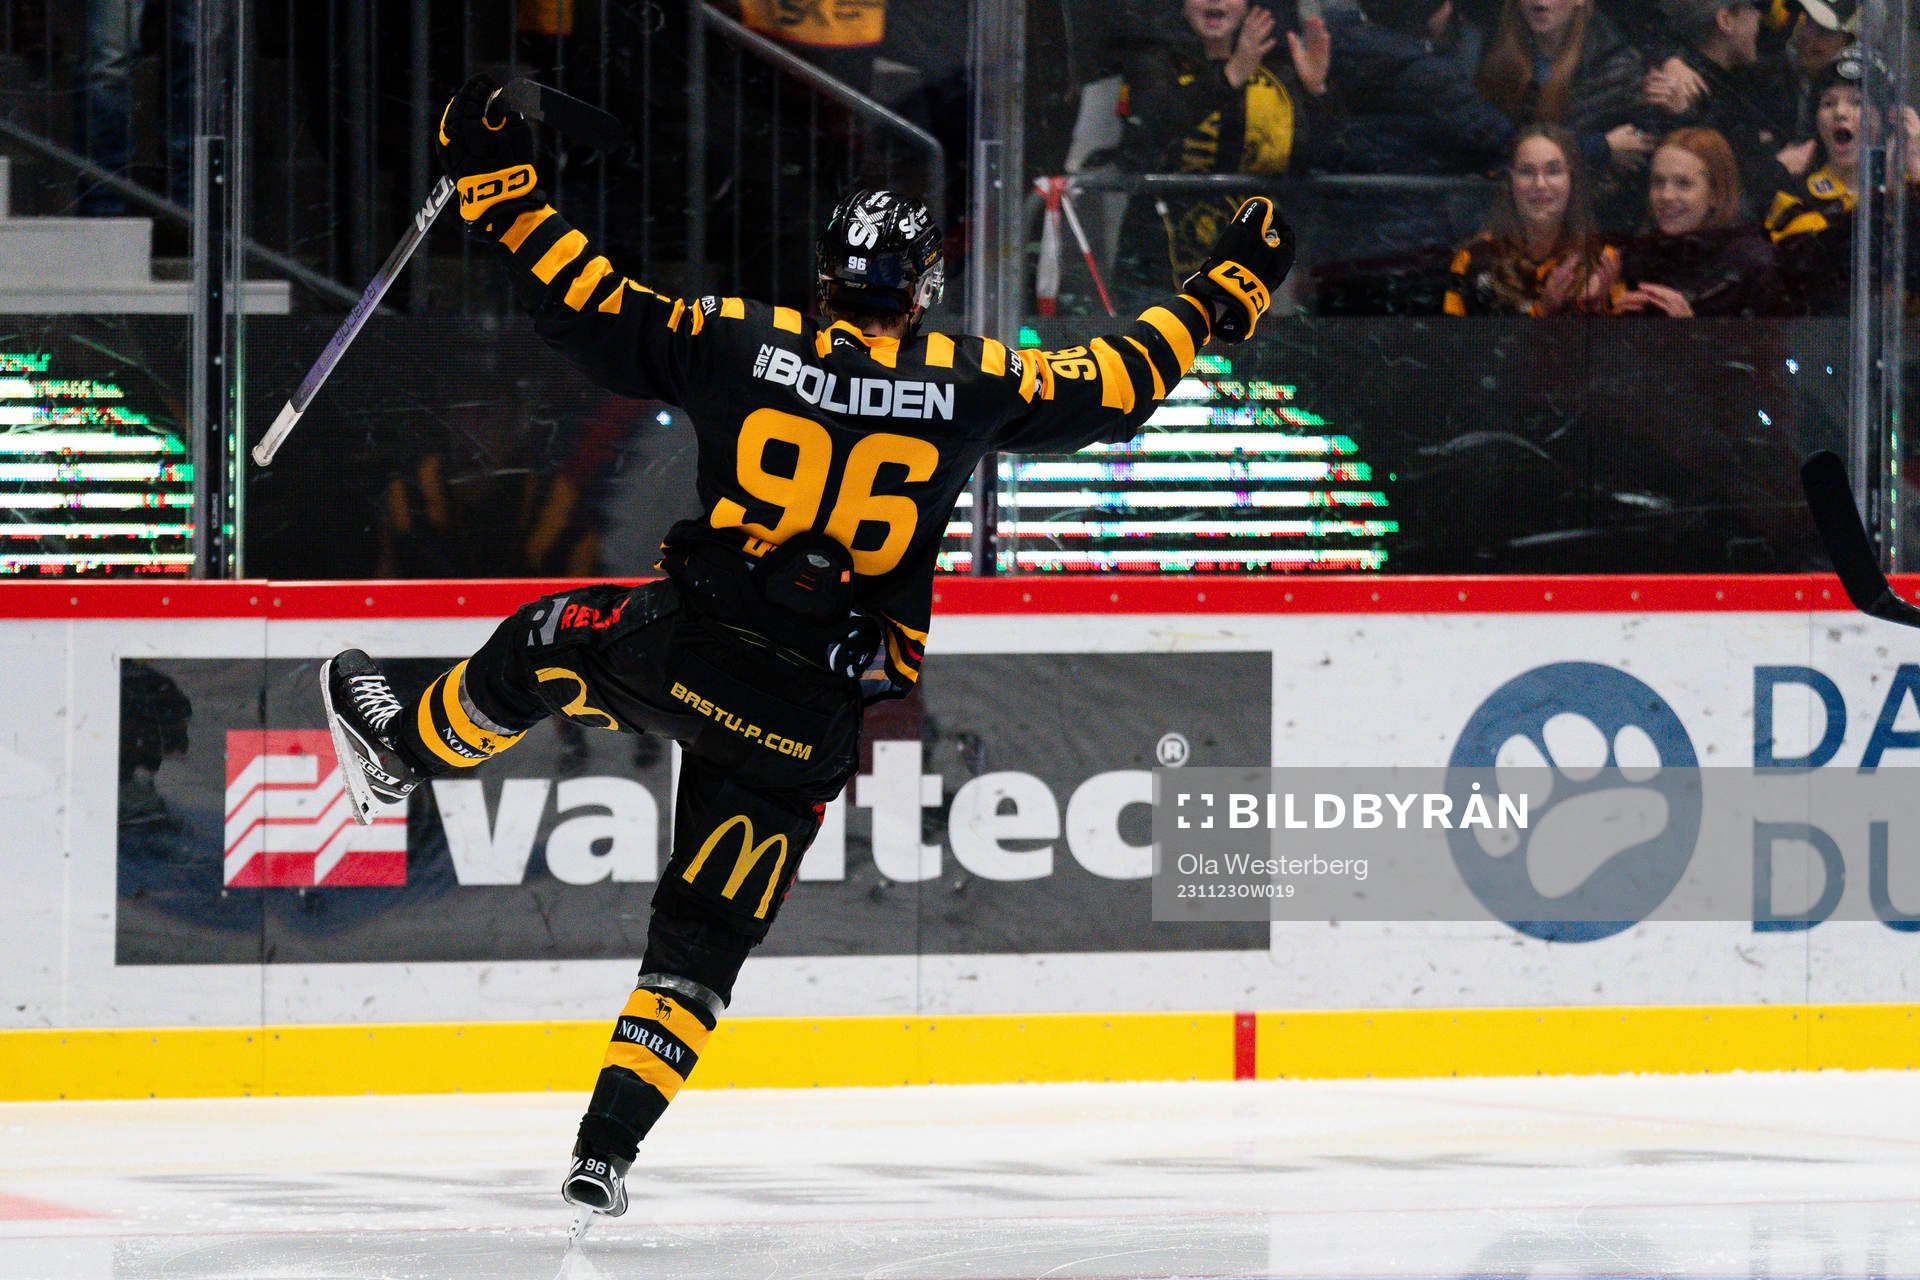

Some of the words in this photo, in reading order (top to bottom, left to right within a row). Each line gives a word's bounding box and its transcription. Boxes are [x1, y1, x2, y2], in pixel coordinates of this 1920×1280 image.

[415, 173, 450, 232] CM
[460, 168, 530, 207] CCM
[847, 255, 868, 271] 96
[752, 343, 774, 378] NEW
[764, 348, 955, 421] BOLIDEN
[709, 407, 940, 576] 96
[670, 681, 813, 760] BASTU-P.COM
[618, 1019, 685, 1064] NORRAN
[585, 1158, 606, 1175] 96
